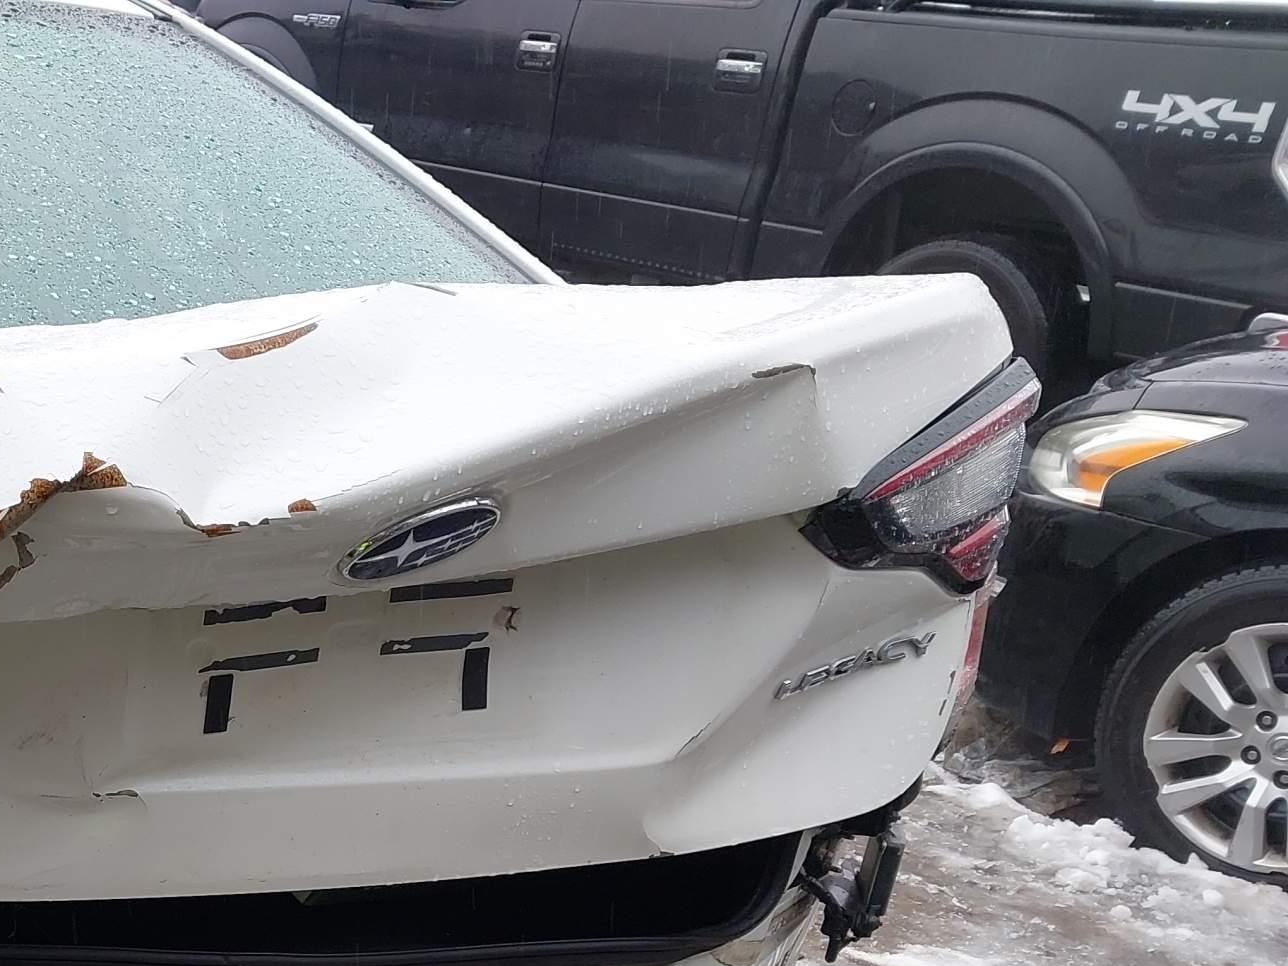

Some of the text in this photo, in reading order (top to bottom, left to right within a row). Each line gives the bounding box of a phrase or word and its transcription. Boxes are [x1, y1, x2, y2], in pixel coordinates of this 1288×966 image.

[1114, 120, 1263, 144] OFF ROAD
[1122, 89, 1277, 134] 4X4
[773, 631, 937, 701] LEGACY
